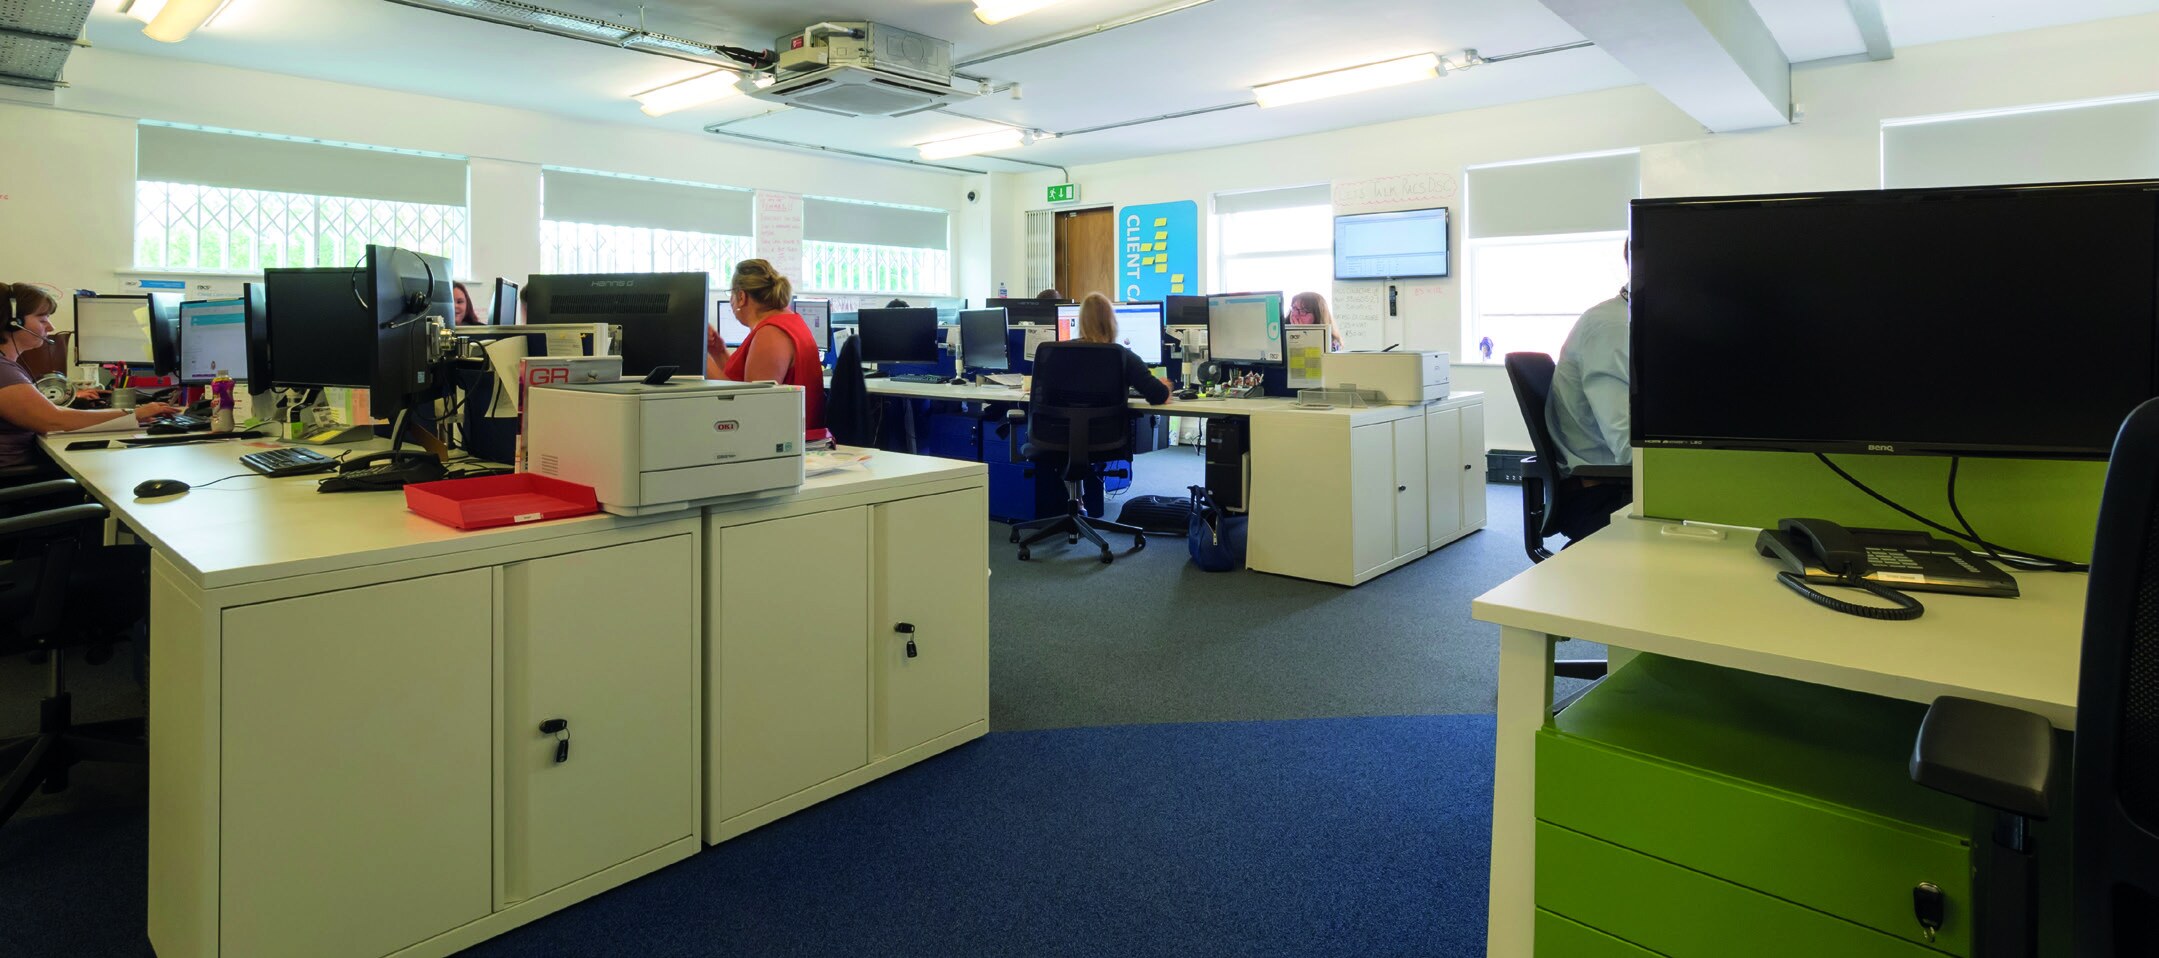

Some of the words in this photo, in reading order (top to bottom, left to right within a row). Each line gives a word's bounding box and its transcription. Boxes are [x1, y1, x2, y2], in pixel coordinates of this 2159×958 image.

[1126, 214, 1140, 280] CLIENT
[529, 367, 569, 385] GR
[717, 423, 734, 431] OKI
[1868, 444, 1895, 453] BenQ
